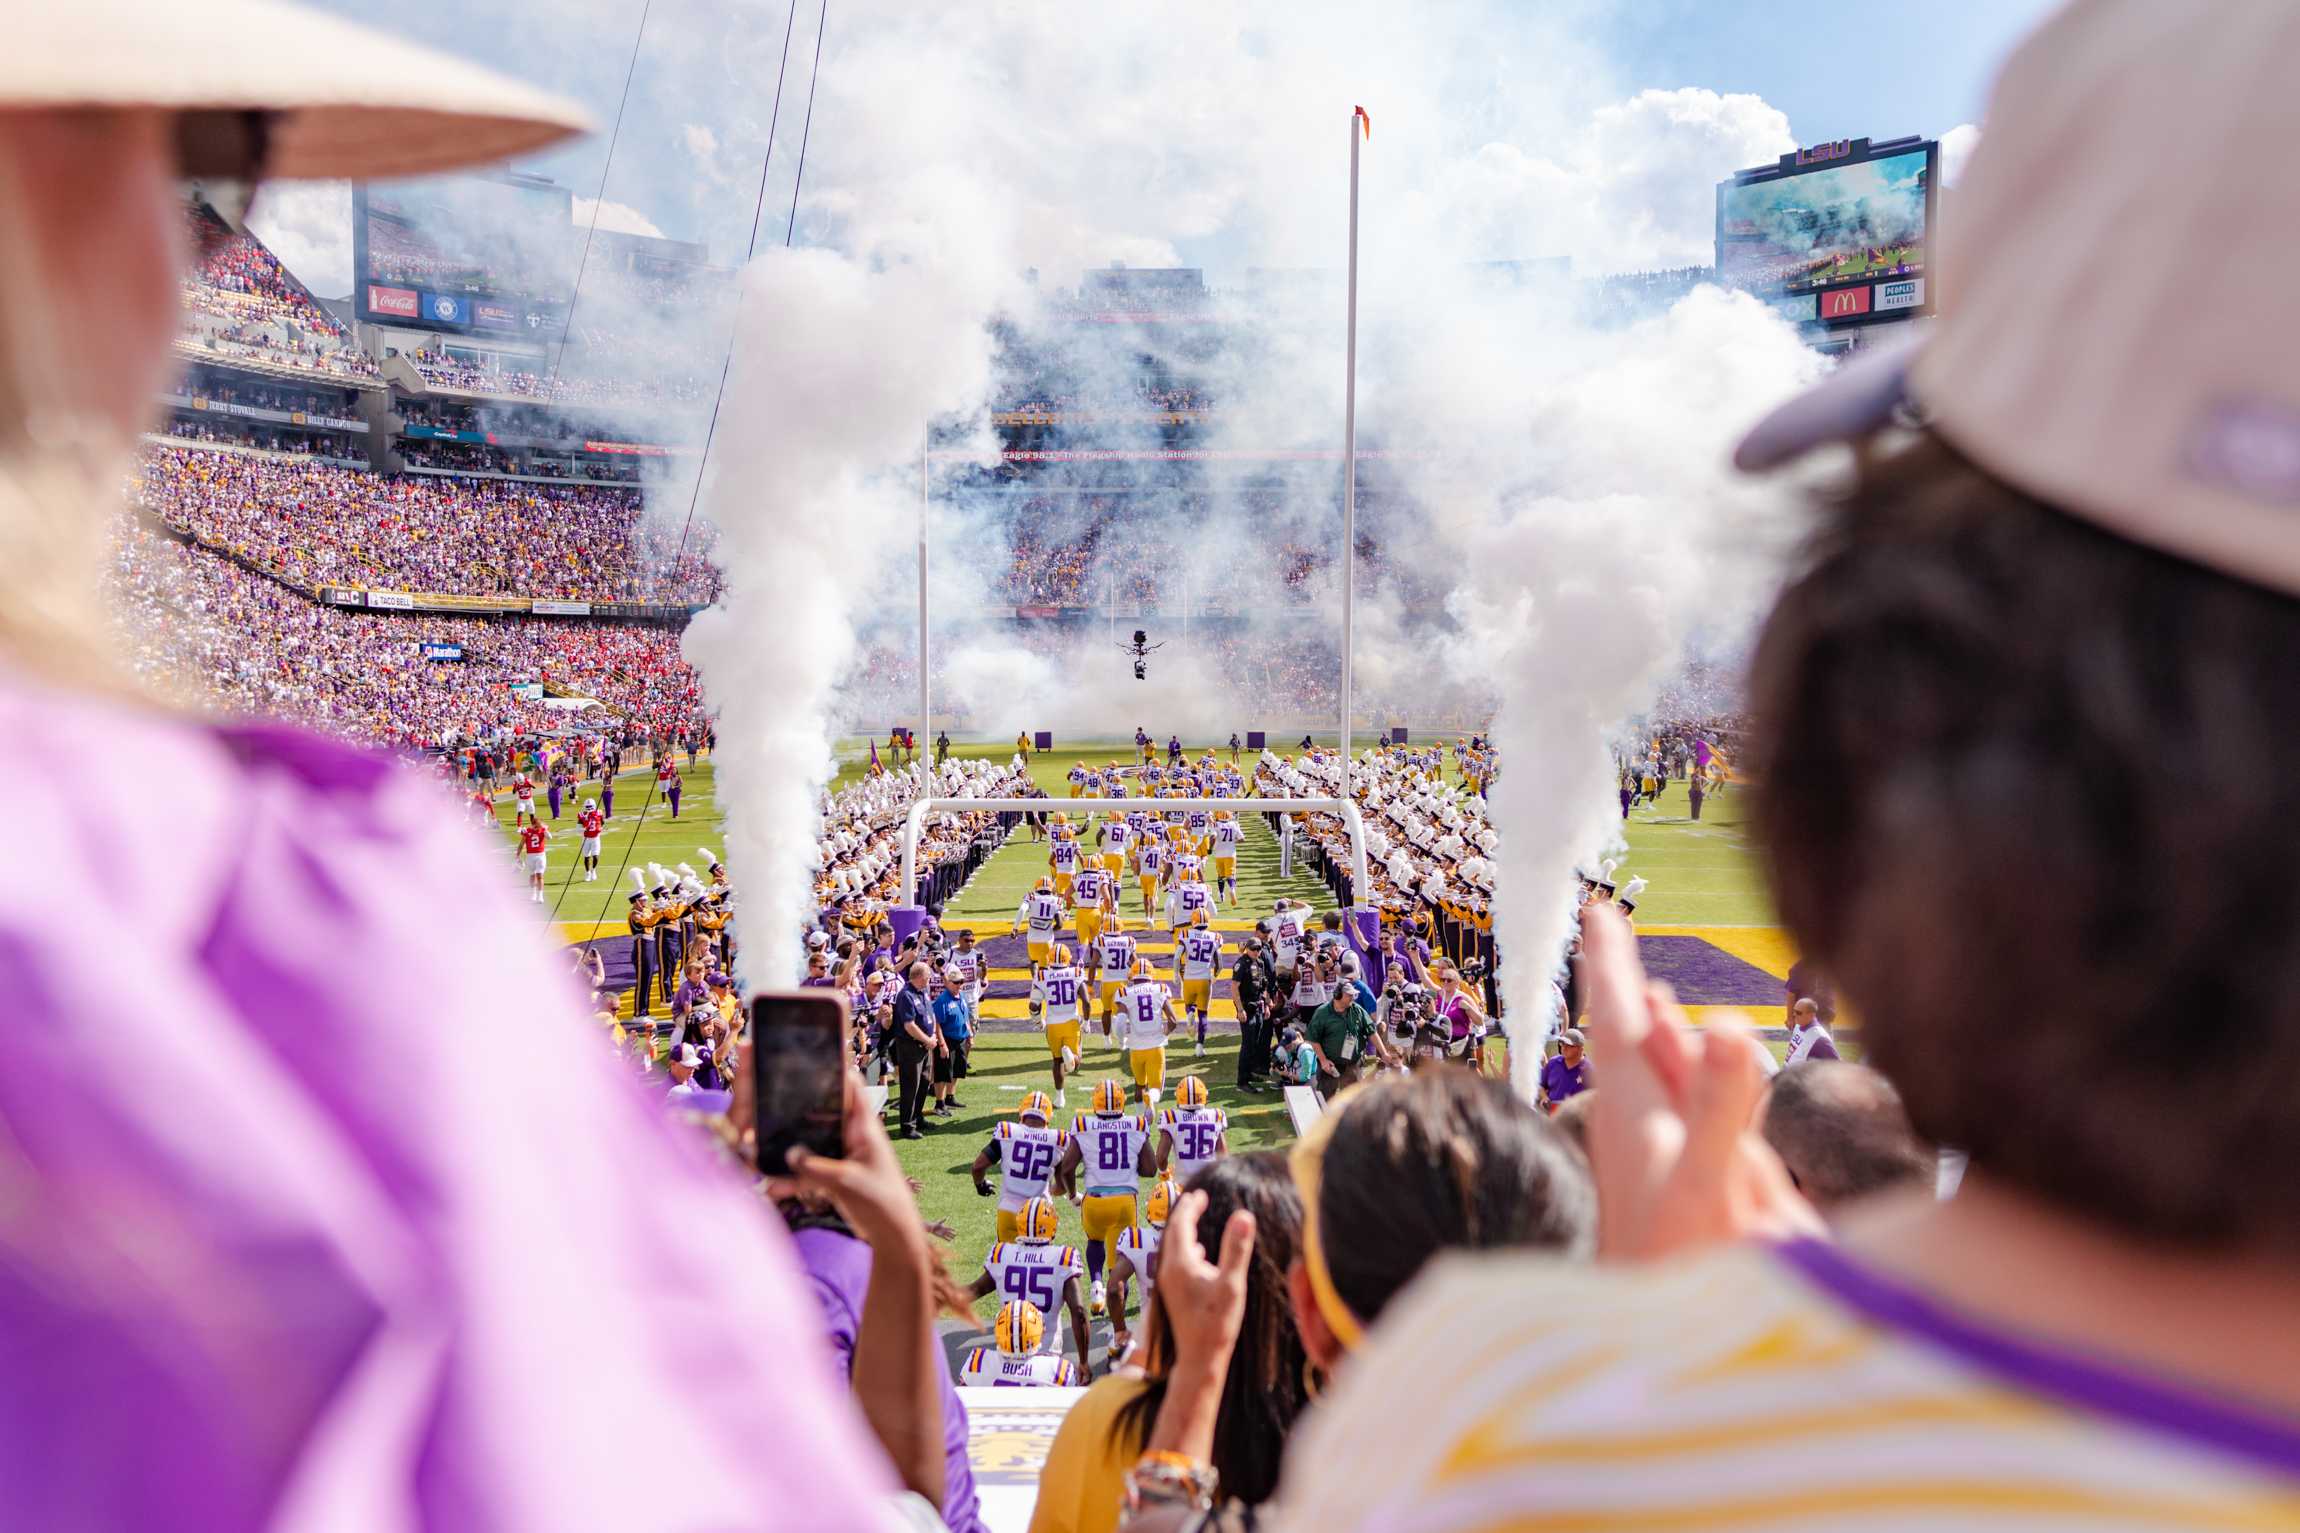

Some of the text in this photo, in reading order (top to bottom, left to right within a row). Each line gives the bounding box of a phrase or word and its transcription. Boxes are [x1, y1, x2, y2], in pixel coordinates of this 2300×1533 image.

[1796, 139, 1850, 166] LSU
[1003, 452, 1029, 460] Eagle
[433, 646, 461, 658] Marathon
[1073, 771, 1084, 781] 94
[1128, 817, 1142, 832] 93
[1190, 815, 1205, 828] 85
[531, 834, 540, 848] 2
[1111, 827, 1124, 842] 61
[1221, 828, 1233, 842] 71
[1055, 848, 1073, 863] 84
[1145, 853, 1158, 869] 41
[1077, 880, 1097, 899] 45
[1183, 891, 1204, 911] 52
[1039, 902, 1051, 917] 11
[1188, 939, 1214, 963] 32
[955, 958, 974, 966] LSU
[1107, 948, 1126, 970] 31
[1046, 979, 1076, 1006] 30
[1137, 994, 1154, 1022] 8
[1182, 1112, 1209, 1122] BROWN
[1091, 1120, 1132, 1130] LANGSTON
[1023, 1132, 1048, 1143] WINGO
[1177, 1123, 1216, 1160] 36
[1098, 1131, 1131, 1170] 81
[1009, 1140, 1054, 1182] 92
[1014, 1251, 1046, 1264] T. HILL
[1004, 1265, 1055, 1314] 95
[1002, 1361, 1033, 1377] BUSH
